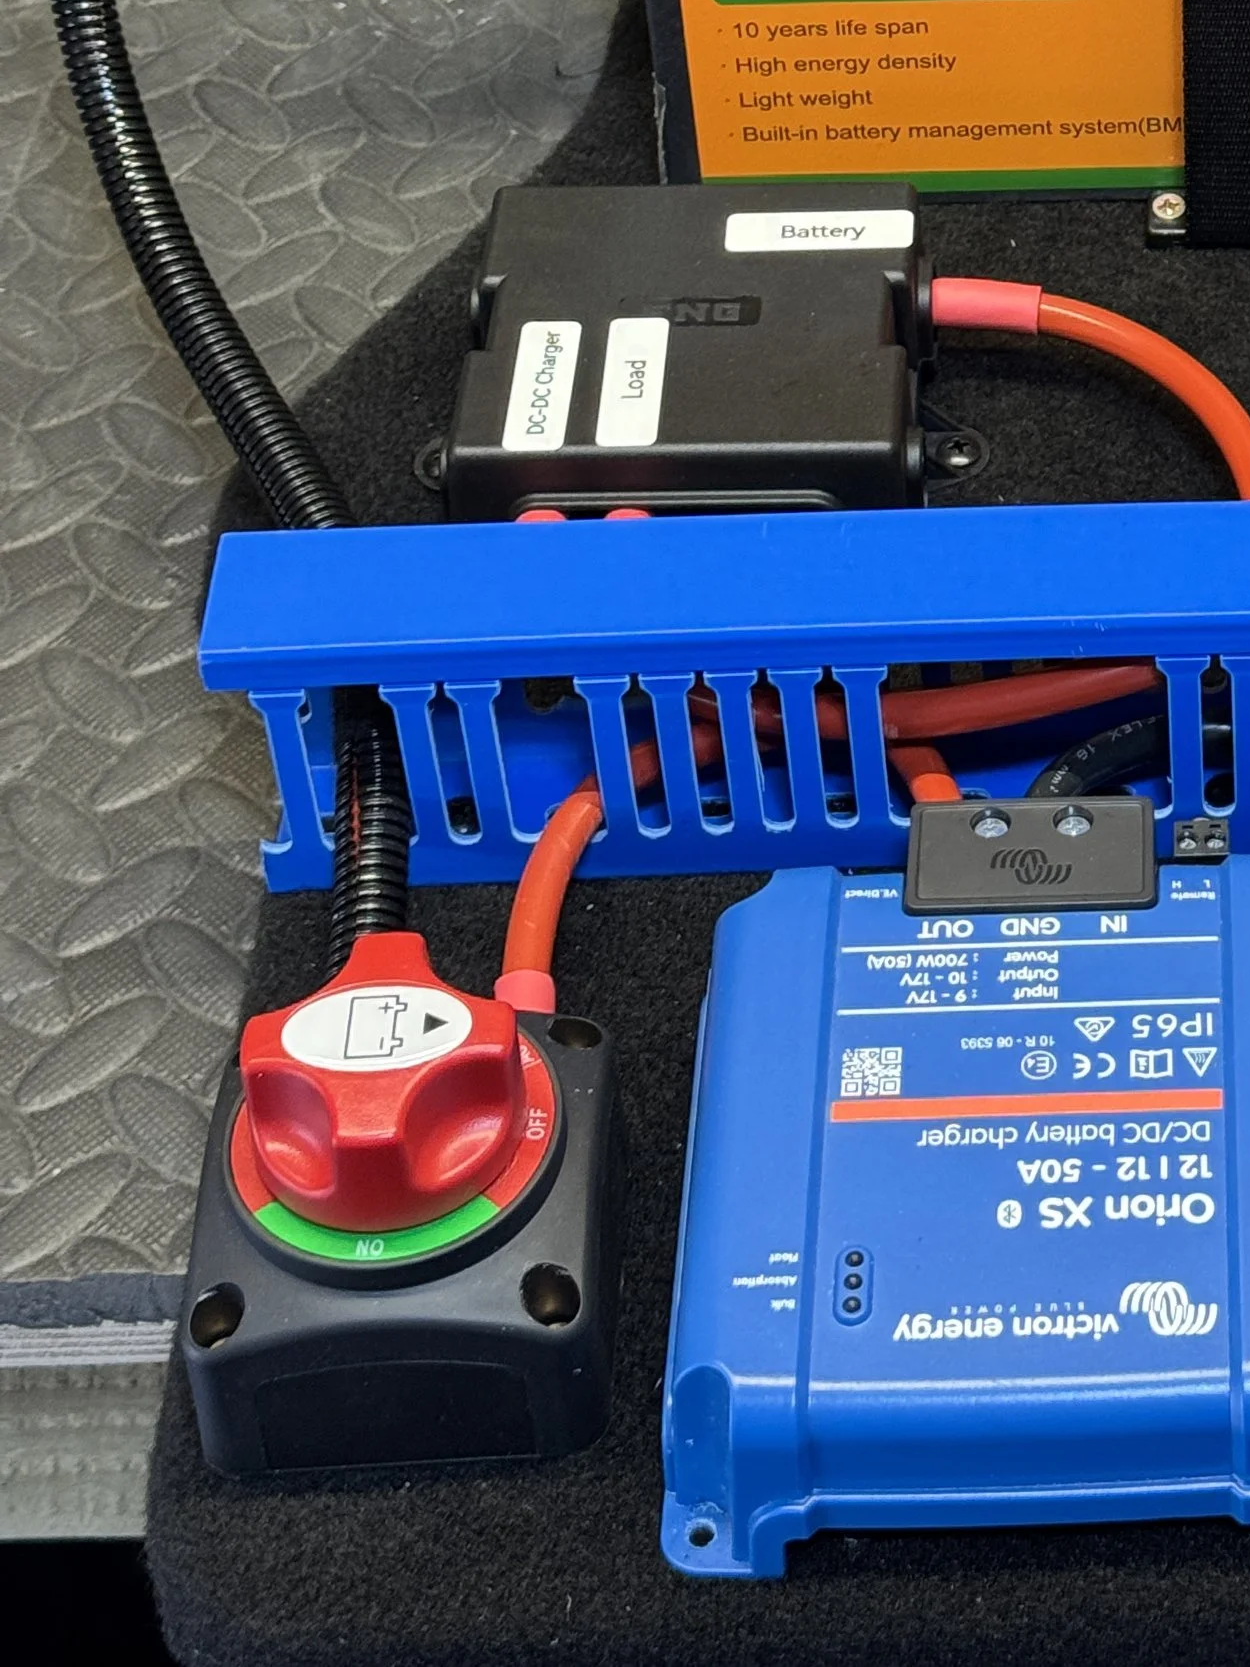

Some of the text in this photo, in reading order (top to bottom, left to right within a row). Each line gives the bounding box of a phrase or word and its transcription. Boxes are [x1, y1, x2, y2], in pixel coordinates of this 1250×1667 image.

[733, 19, 929, 43] 10 years life span
[736, 52, 956, 77] High energy density
[739, 89, 873, 111] Light weight
[743, 116, 1183, 144] Built-in battery management system(BM
[781, 224, 866, 241] Battery
[526, 331, 564, 435] DC-DC Charger
[621, 359, 647, 400] Load
[845, 888, 898, 899] VE.Direct
[1171, 890, 1216, 901] Remote
[918, 919, 974, 939] OUT
[1001, 916, 1061, 935] GND
[1101, 915, 1127, 933] IN
[867, 954, 912, 970] (50A)
[917, 953, 968, 967] 700W
[1004, 950, 1059, 964] Power
[901, 973, 931, 986] 17V
[948, 972, 967, 984] 10
[998, 967, 1059, 982] Output
[906, 990, 937, 1004] 17V
[956, 990, 967, 1003] 9
[1014, 985, 1059, 1000] Input
[1132, 1012, 1213, 1038] IP65
[1025, 1037, 1034, 1048] R
[1039, 1036, 1056, 1047] 10
[526, 1107, 548, 1141] OFF
[917, 1121, 1212, 1149] DC/DC battery charger
[1017, 1158, 1083, 1185] 50A
[1116, 1156, 1151, 1181] 12
[1179, 1154, 1213, 1179] 12
[1038, 1192, 1215, 1229] Orion XS
[892, 1312, 1120, 1342] victron energy
